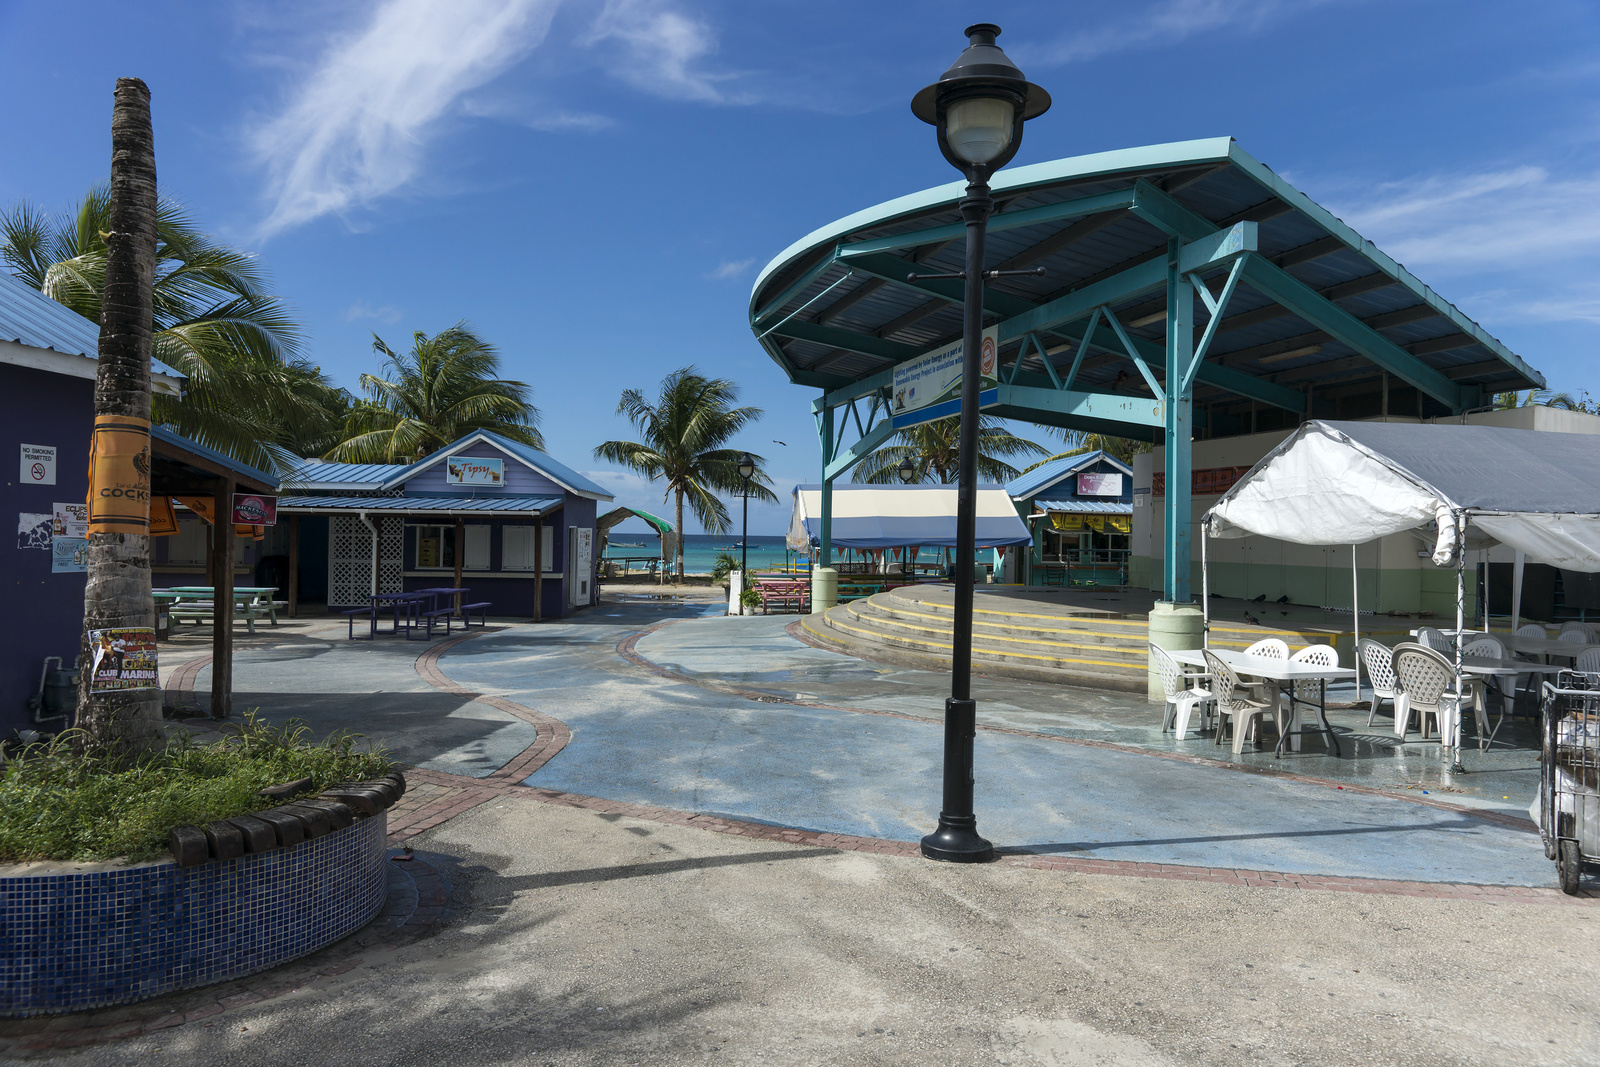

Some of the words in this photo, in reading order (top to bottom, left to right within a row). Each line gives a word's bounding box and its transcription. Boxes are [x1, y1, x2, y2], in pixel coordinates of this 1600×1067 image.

[906, 363, 918, 375] powered
[931, 354, 943, 364] Energy
[958, 344, 963, 353] of
[895, 376, 911, 386] Renewable
[911, 372, 921, 381] Energy
[921, 367, 932, 377] Project
[936, 360, 955, 371] association
[955, 355, 964, 365] with
[31, 448, 55, 456] SMOKING
[461, 463, 490, 479] Tipsy
[98, 669, 119, 677] CLUB
[120, 670, 156, 679] MARINA
